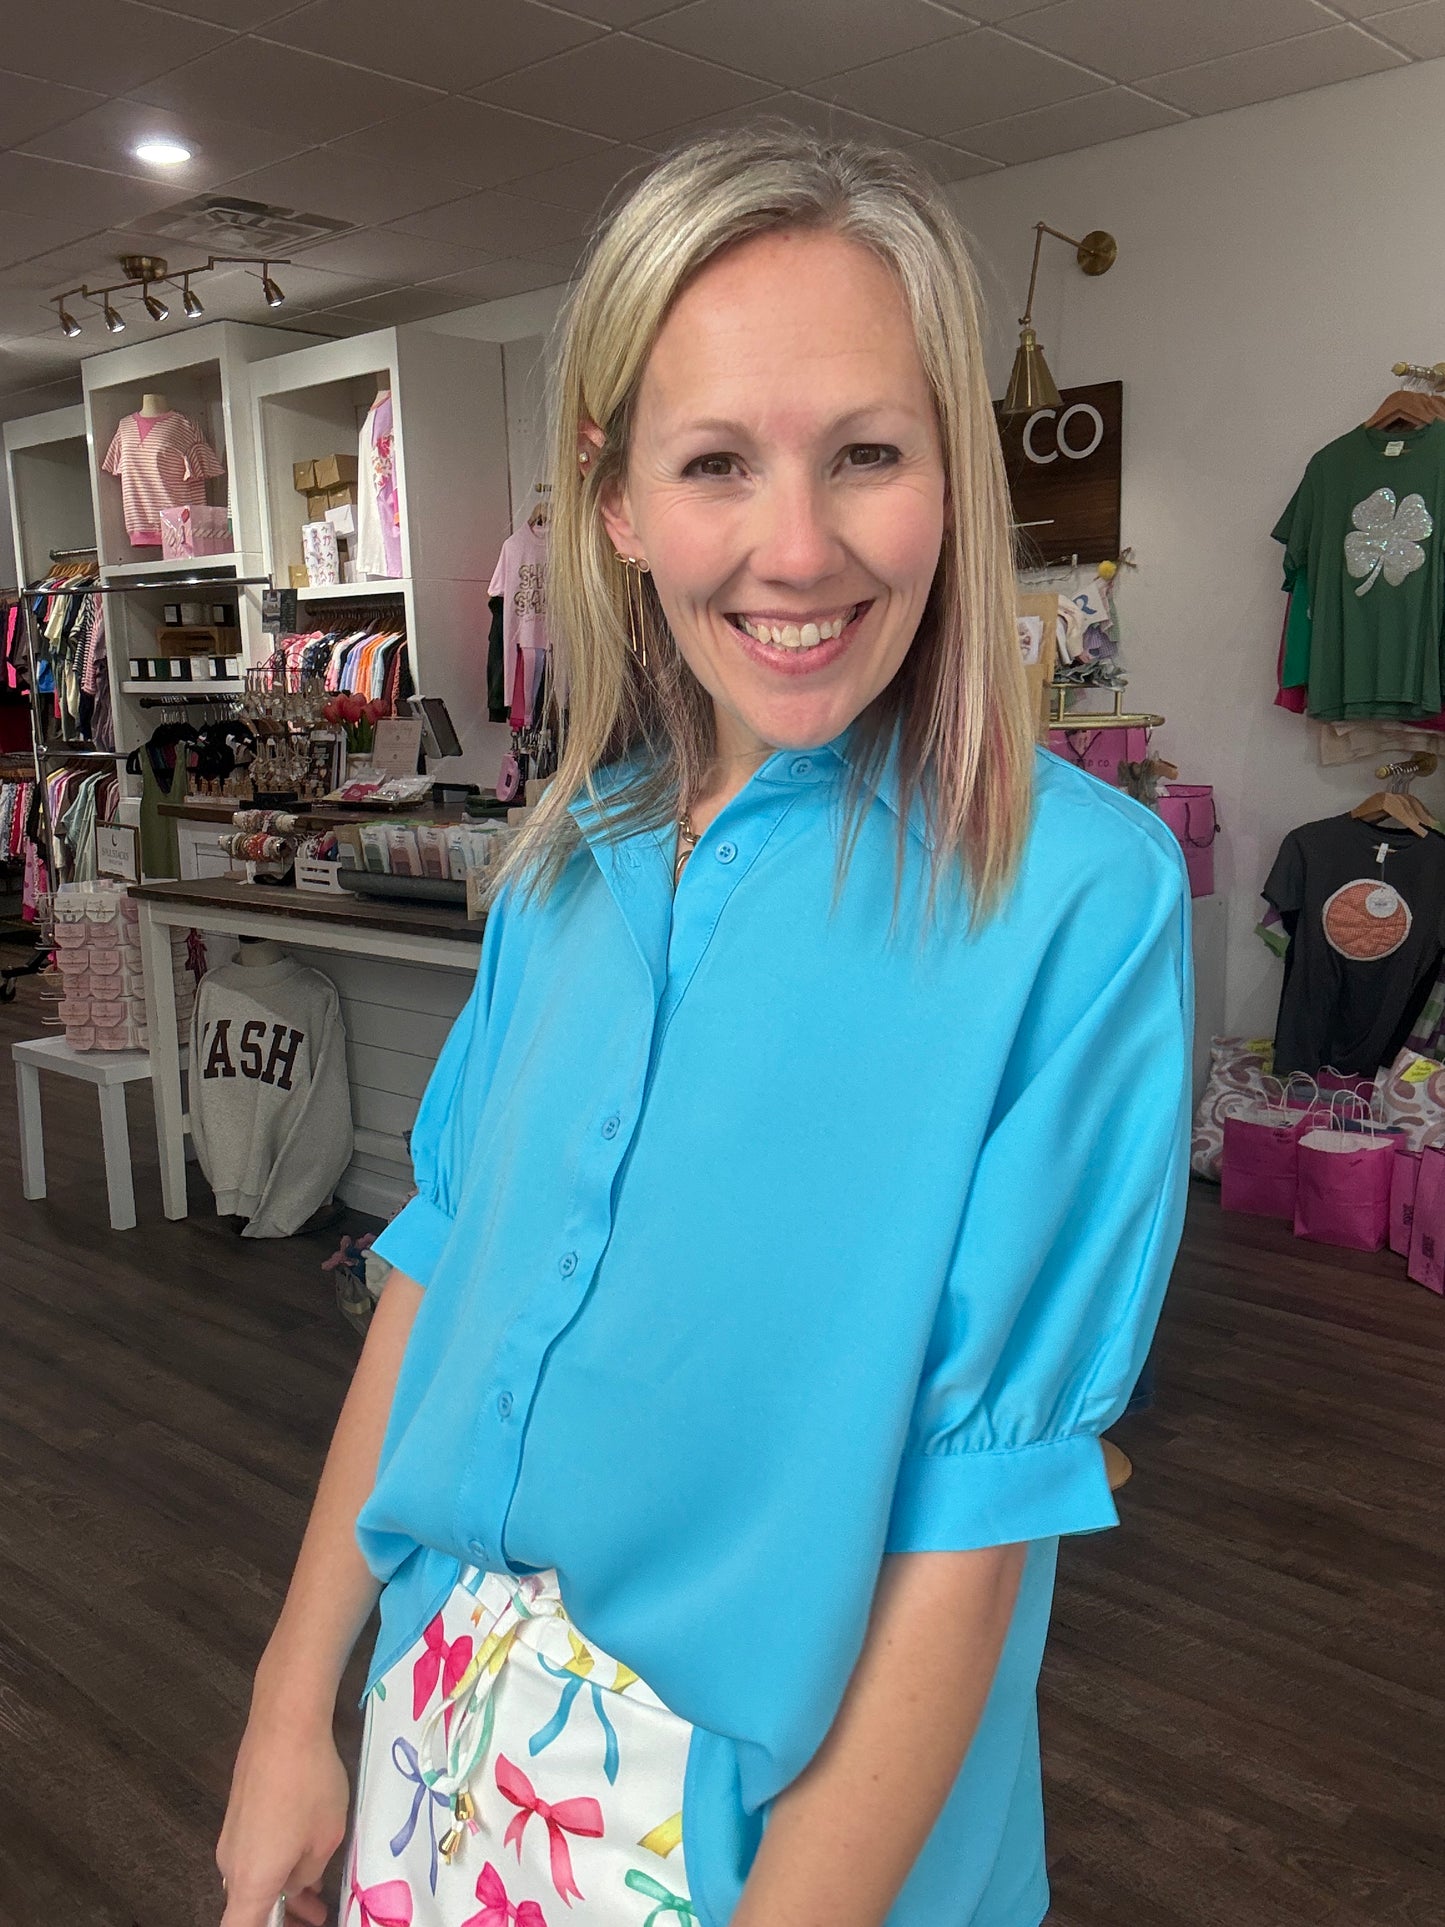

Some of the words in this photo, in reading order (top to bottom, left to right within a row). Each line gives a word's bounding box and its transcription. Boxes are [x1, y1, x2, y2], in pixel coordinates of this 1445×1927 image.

[1022, 403, 1104, 464] CO
[518, 563, 548, 590] SH
[201, 1019, 305, 1091] ASH
